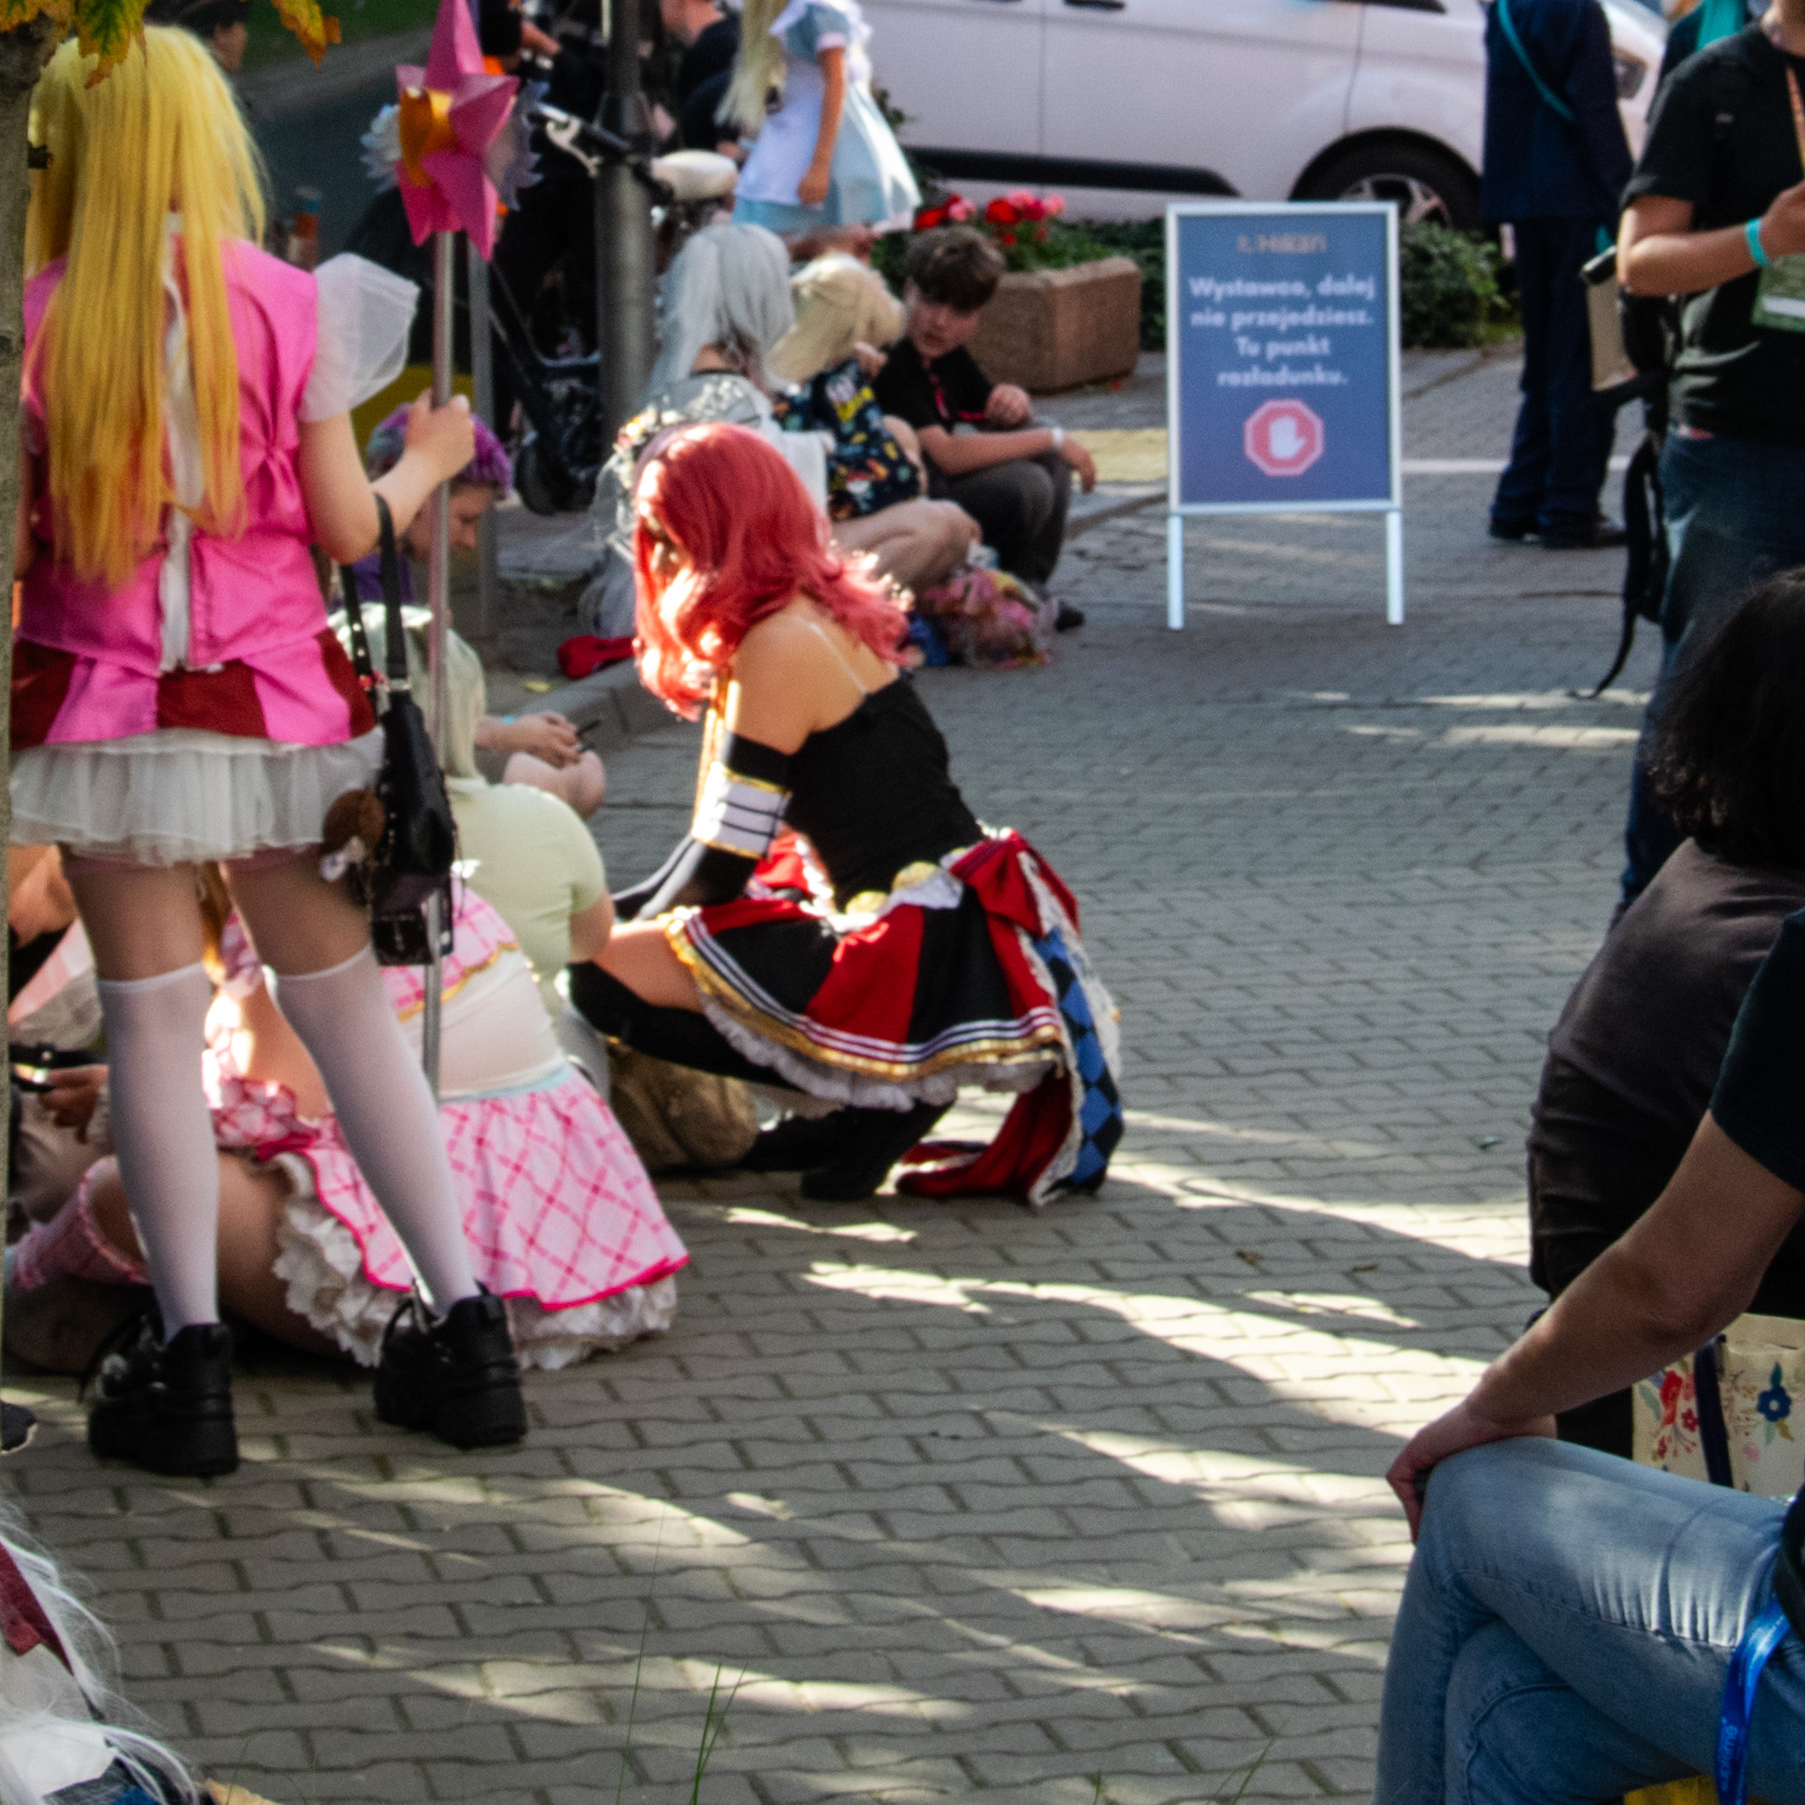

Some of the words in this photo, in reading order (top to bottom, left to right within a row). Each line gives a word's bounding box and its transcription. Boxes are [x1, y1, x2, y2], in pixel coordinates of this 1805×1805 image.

[1316, 273, 1375, 301] dalej
[1190, 307, 1226, 327] nie
[1235, 336, 1261, 356] Tu
[1265, 334, 1331, 362] punkt
